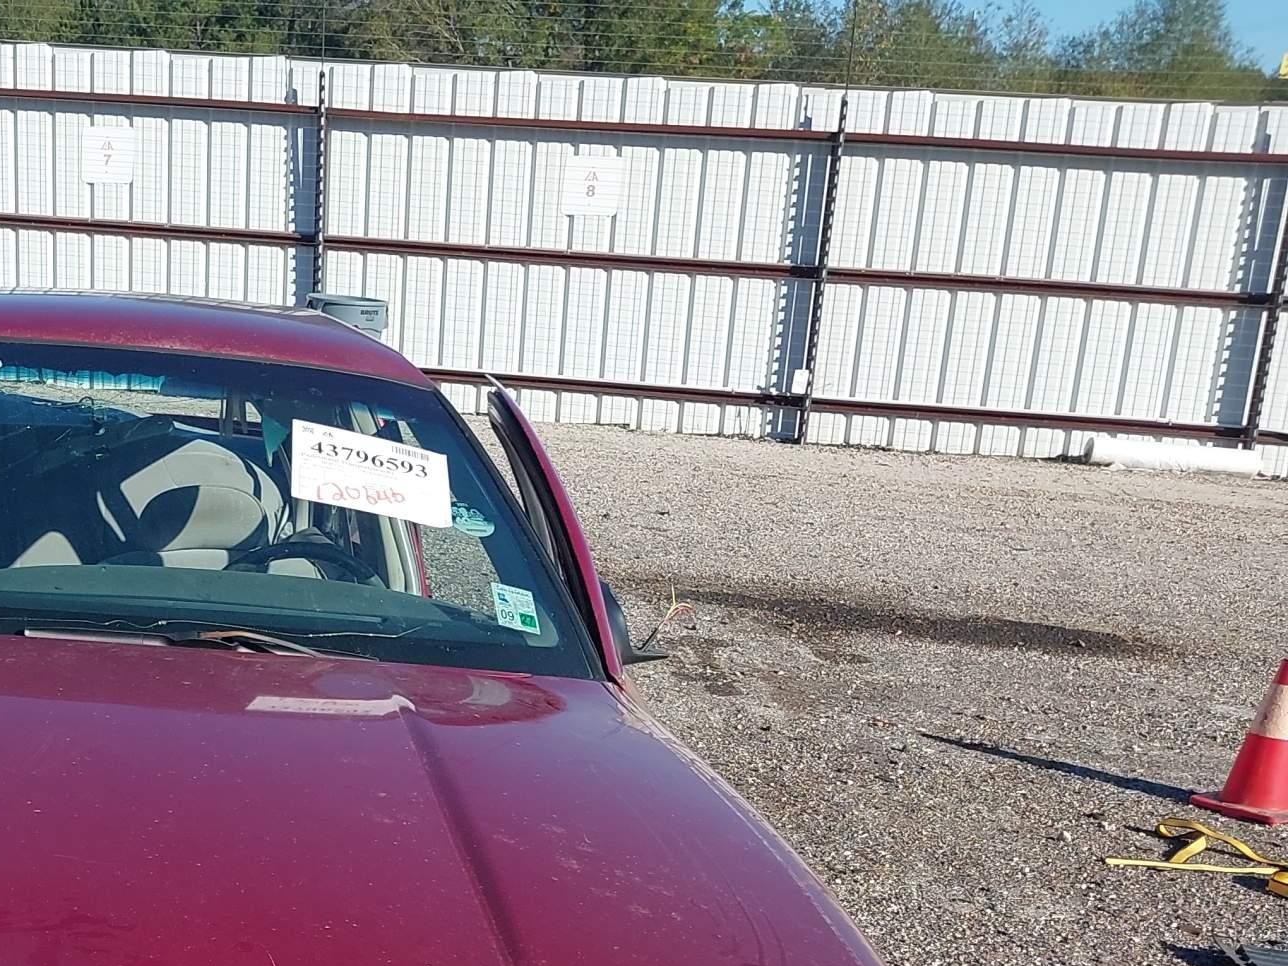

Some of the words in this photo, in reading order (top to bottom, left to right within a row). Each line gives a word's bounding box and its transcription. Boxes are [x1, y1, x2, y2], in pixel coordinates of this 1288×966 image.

[103, 154, 112, 167] 7
[585, 184, 596, 198] 8
[311, 441, 428, 478] 43796593
[500, 608, 515, 621] 09
